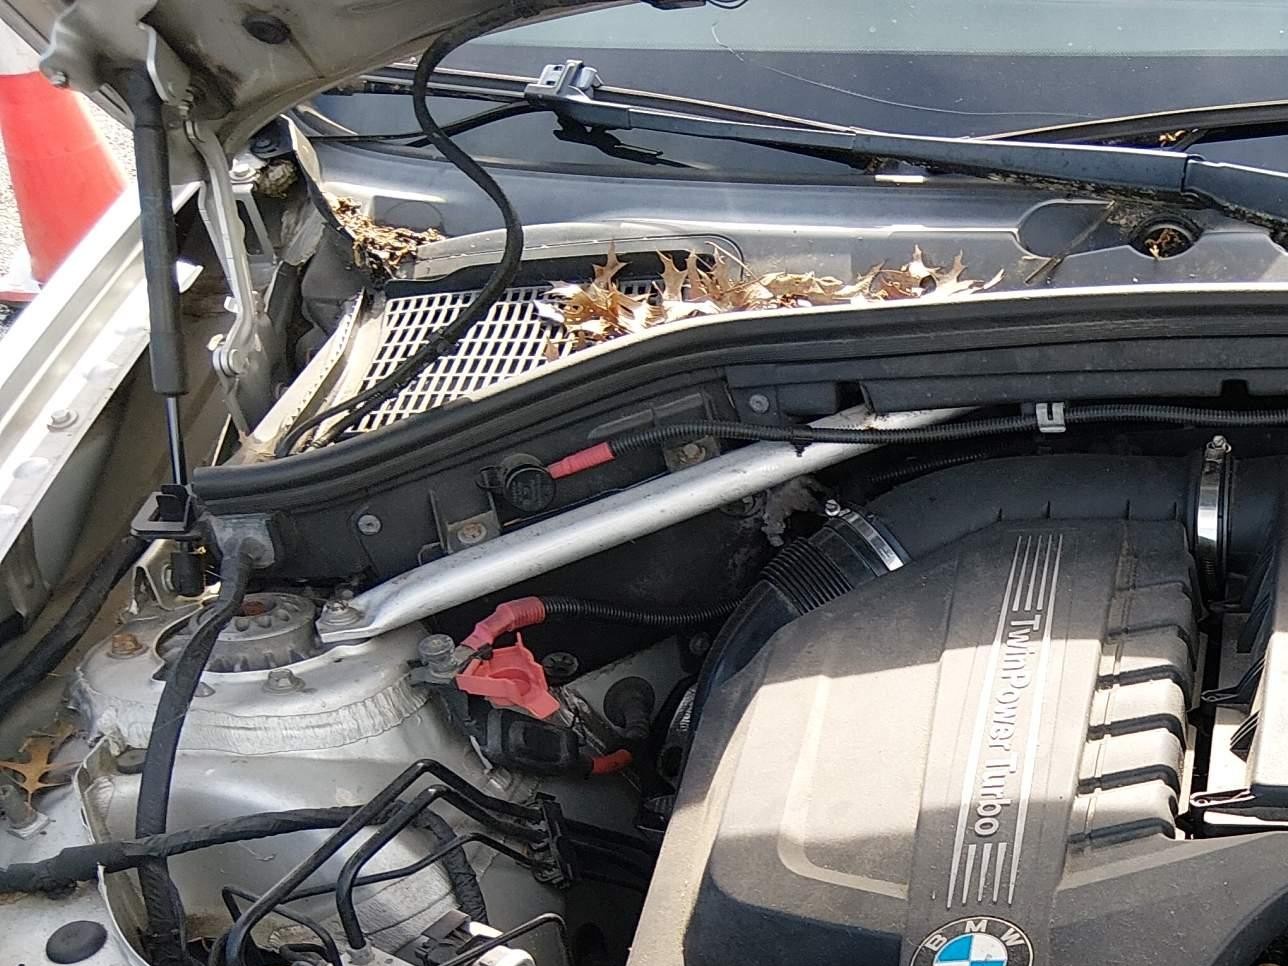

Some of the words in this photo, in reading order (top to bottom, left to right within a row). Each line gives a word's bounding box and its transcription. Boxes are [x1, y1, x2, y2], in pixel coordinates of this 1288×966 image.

[992, 613, 1041, 751] TwinPower
[974, 751, 1017, 836] Turbo
[926, 918, 1025, 951] BMW
